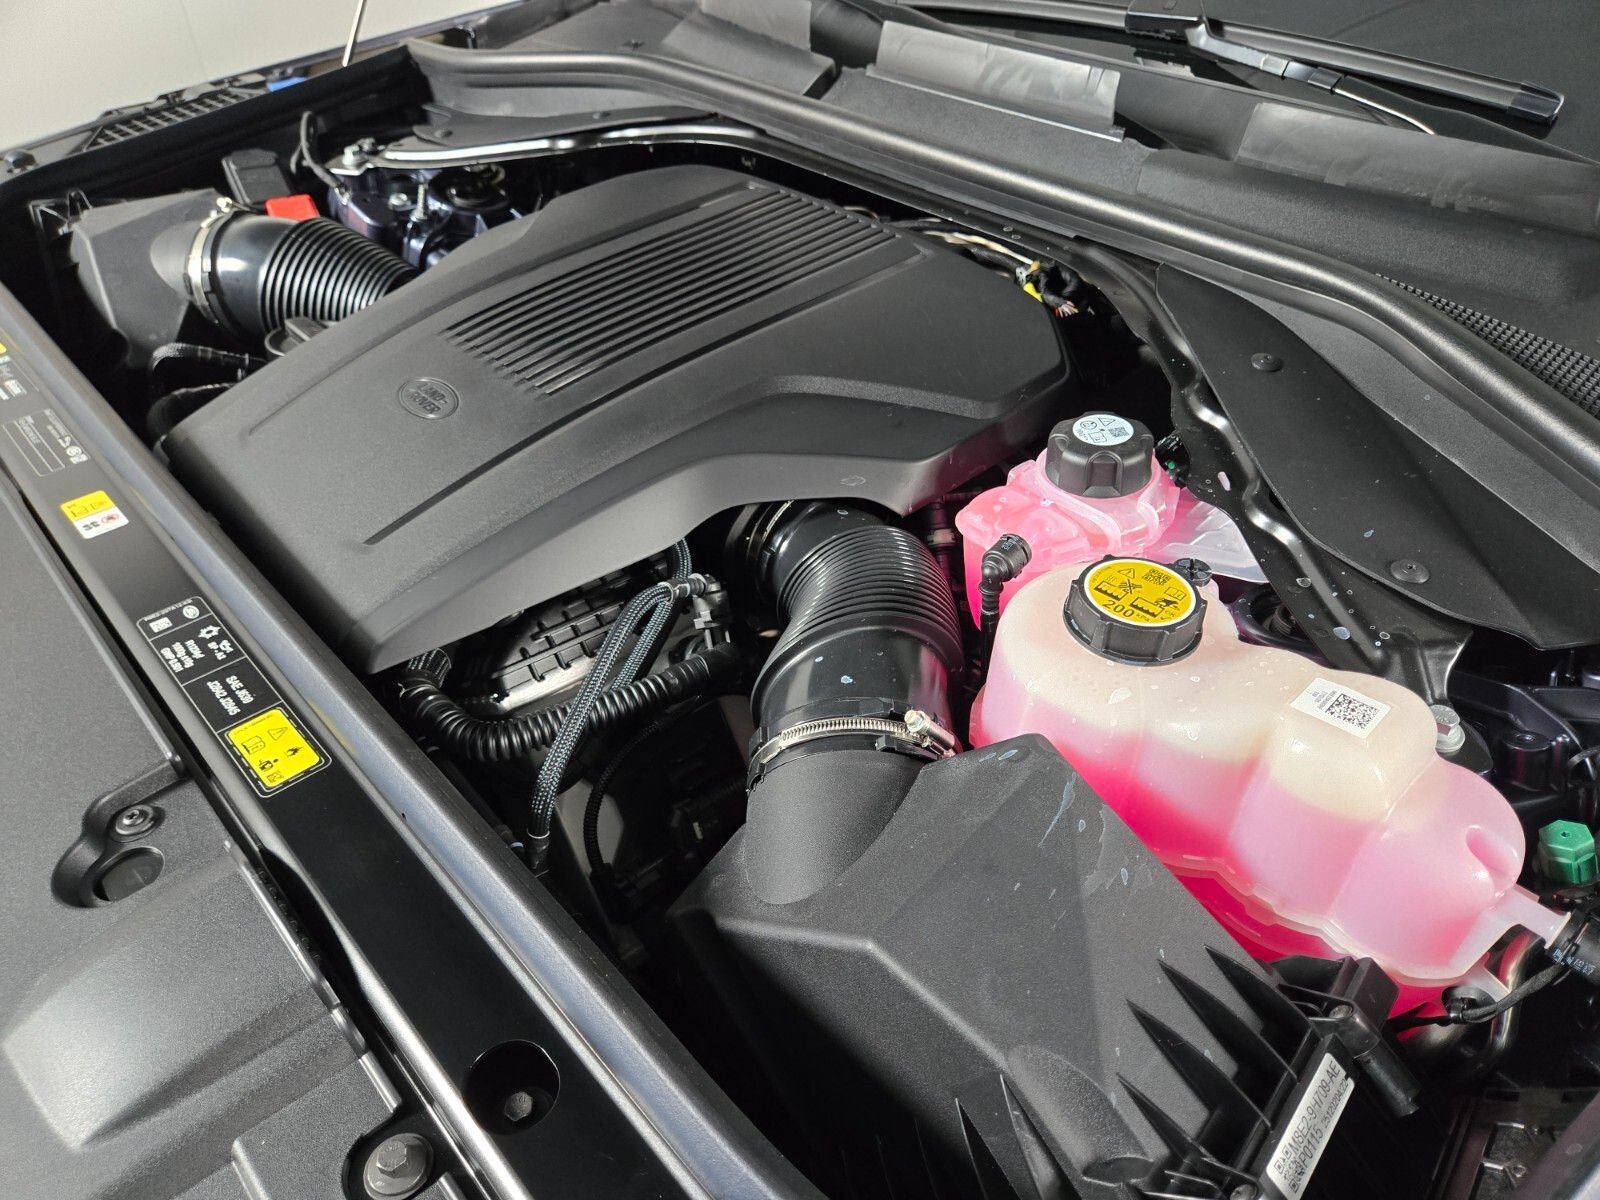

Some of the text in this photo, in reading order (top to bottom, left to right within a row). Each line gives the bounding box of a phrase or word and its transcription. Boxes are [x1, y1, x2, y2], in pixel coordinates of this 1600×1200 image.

[1102, 599, 1135, 618] 200
[206, 680, 228, 699] J2842
[225, 675, 244, 691] SAE
[234, 688, 254, 704] J639
[1297, 1124, 1324, 1168] P0115
